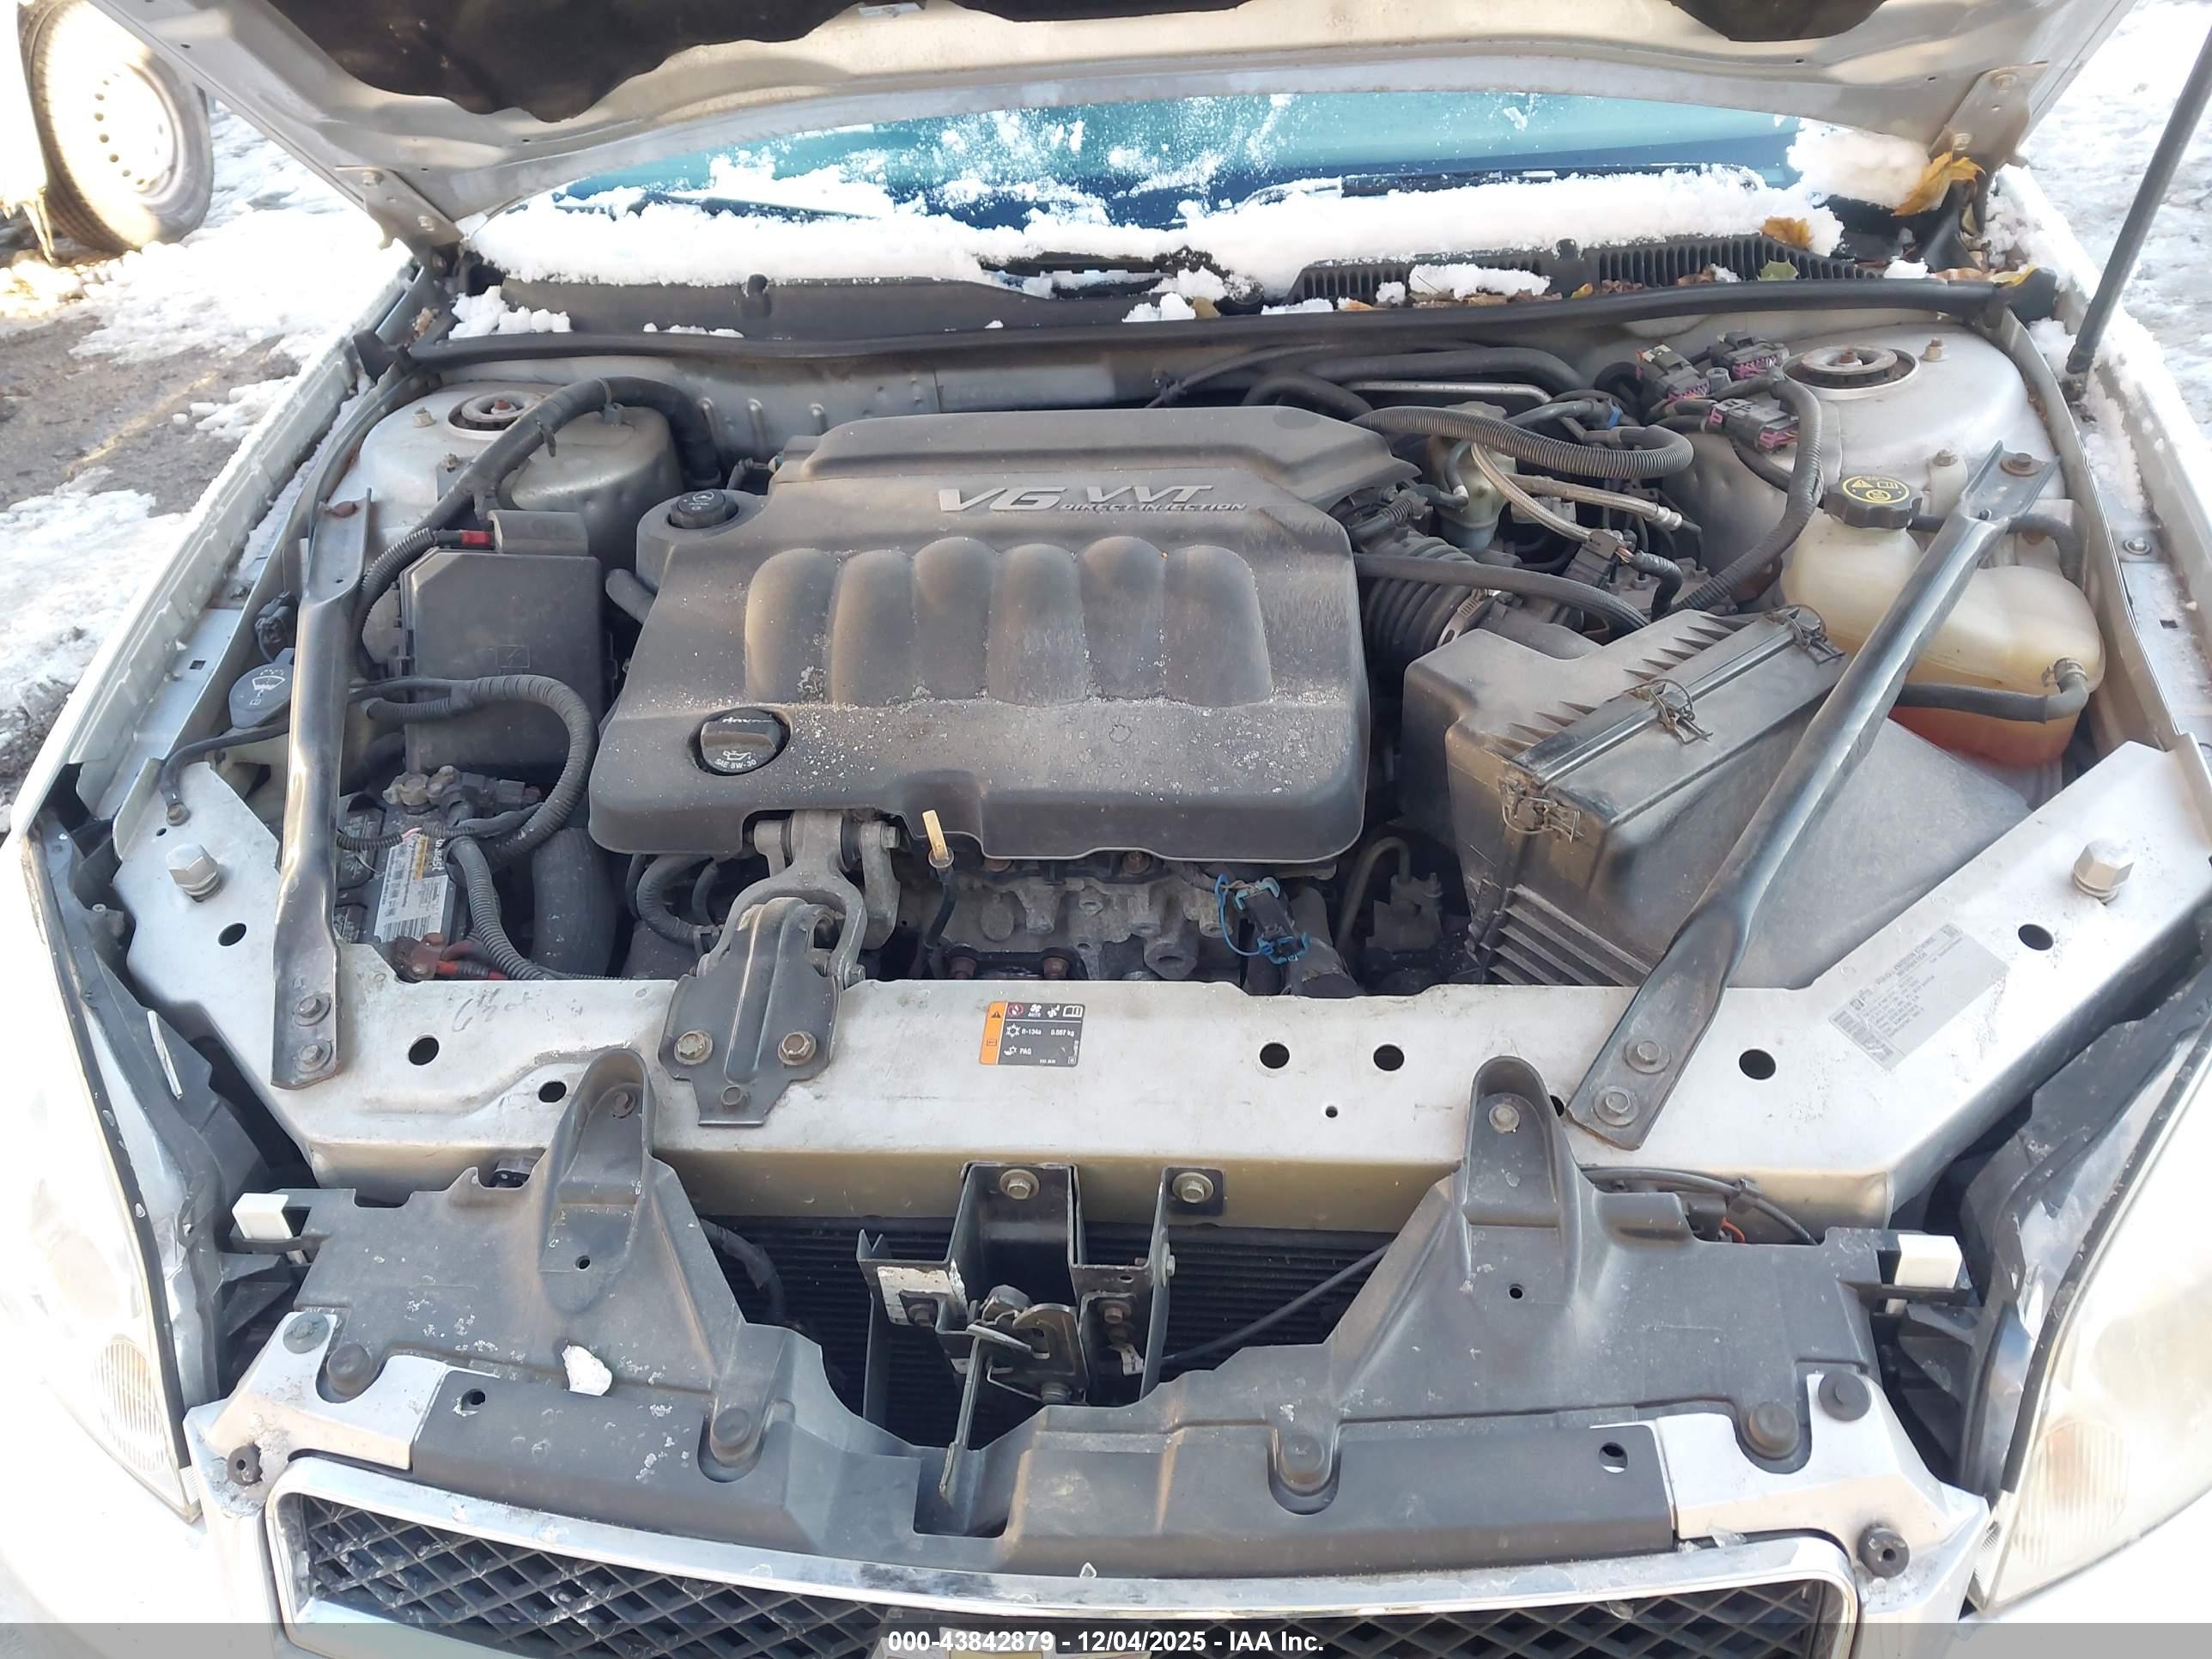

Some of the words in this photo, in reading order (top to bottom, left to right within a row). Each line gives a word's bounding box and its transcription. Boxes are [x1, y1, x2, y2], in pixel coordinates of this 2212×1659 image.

[938, 487, 1067, 512] V6
[1085, 485, 1213, 503] VVT
[1059, 502, 1139, 513] DIRECT
[1139, 501, 1247, 513] INJECTION
[714, 758, 729, 769] SAE
[730, 759, 757, 769] 5W-30
[1019, 1047, 1032, 1055] PAG
